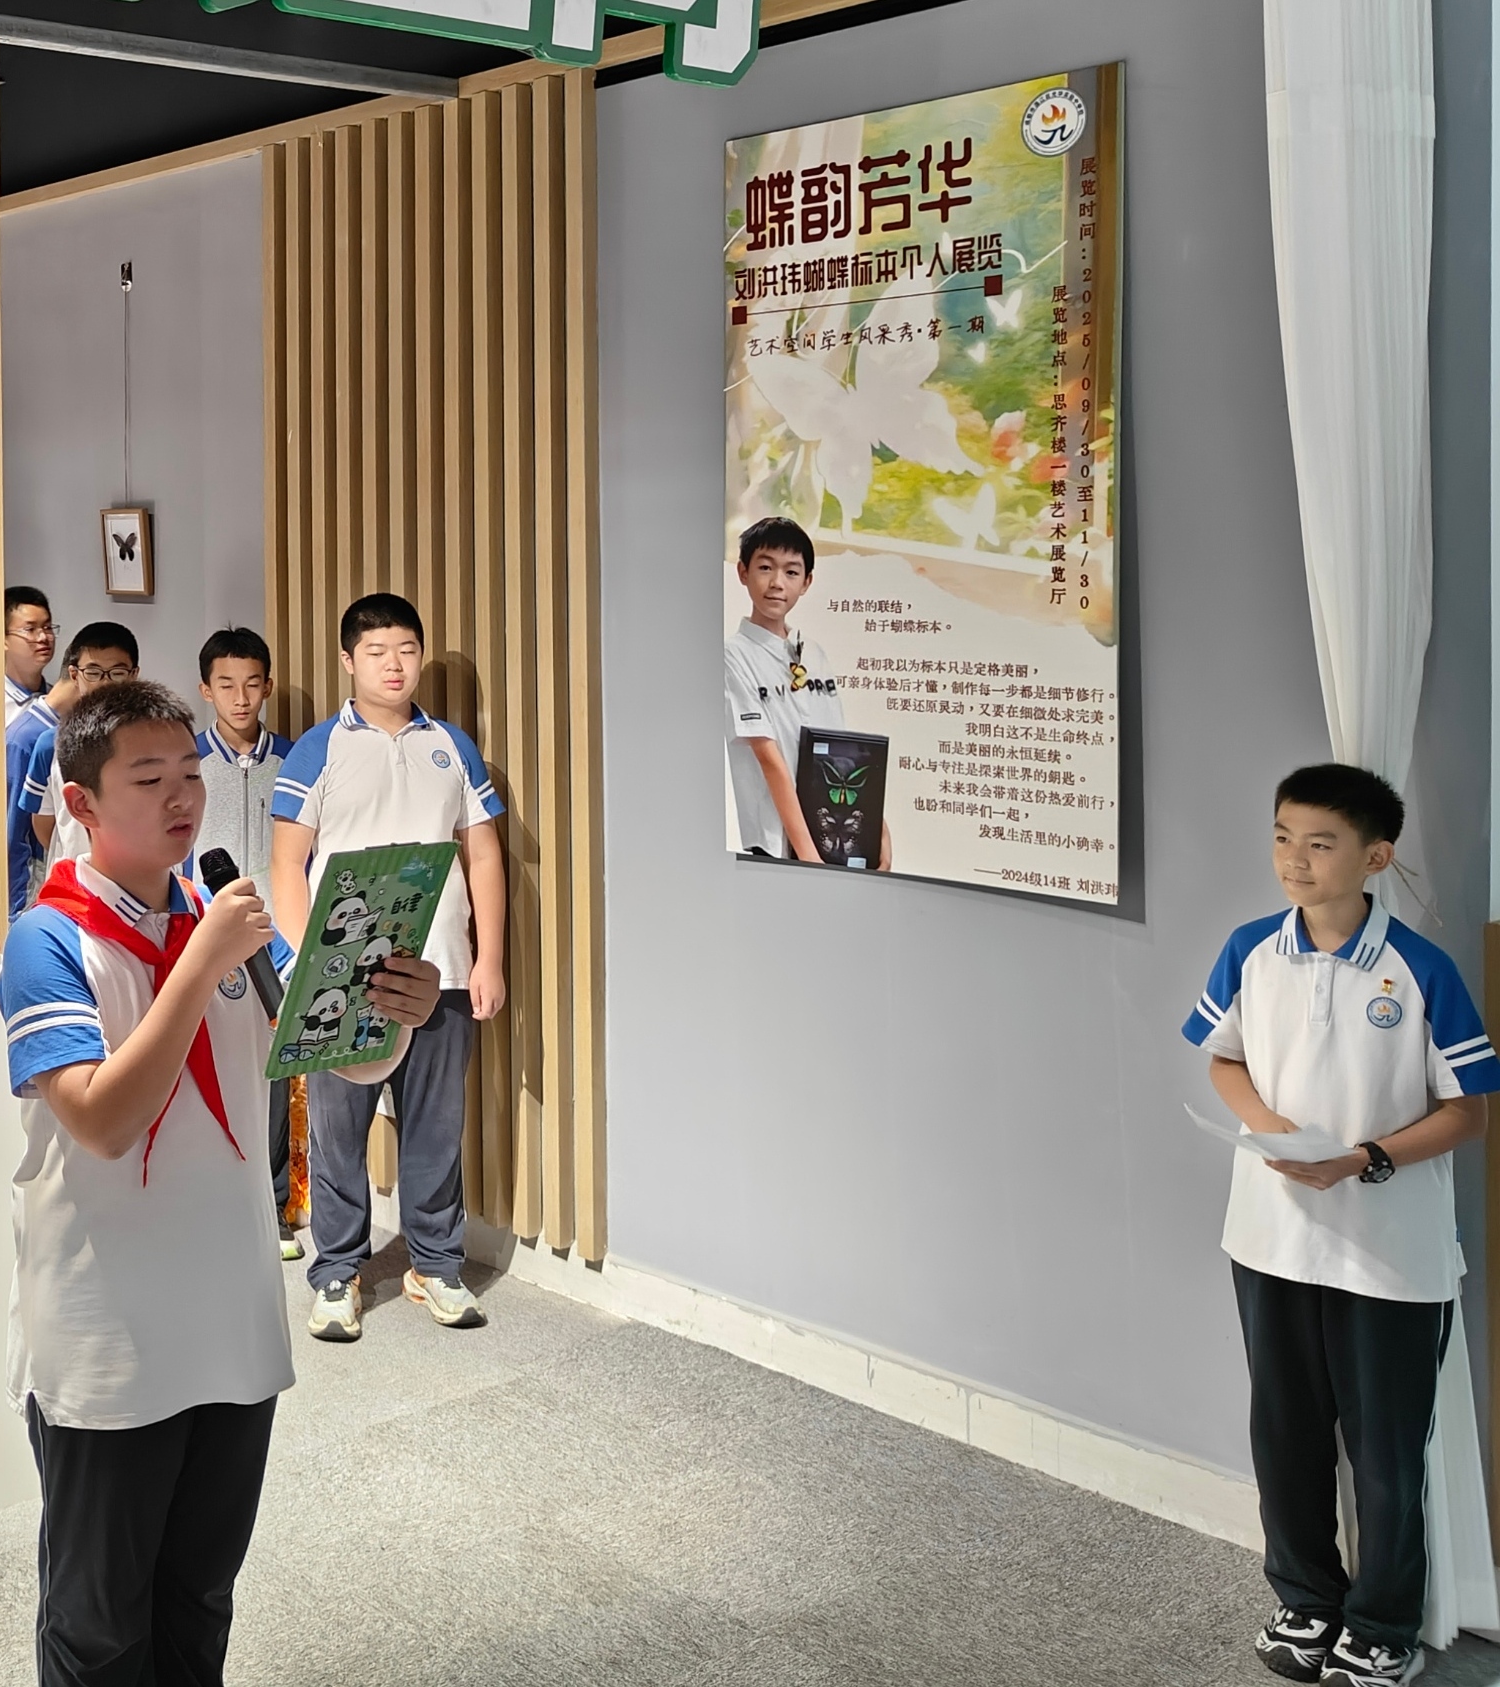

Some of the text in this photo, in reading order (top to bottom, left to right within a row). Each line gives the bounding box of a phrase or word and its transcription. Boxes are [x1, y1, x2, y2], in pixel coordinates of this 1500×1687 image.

[746, 137, 972, 251] 蝶韵芳华
[734, 233, 1003, 301] 刘洪玮蝴蝶标本个人展览
